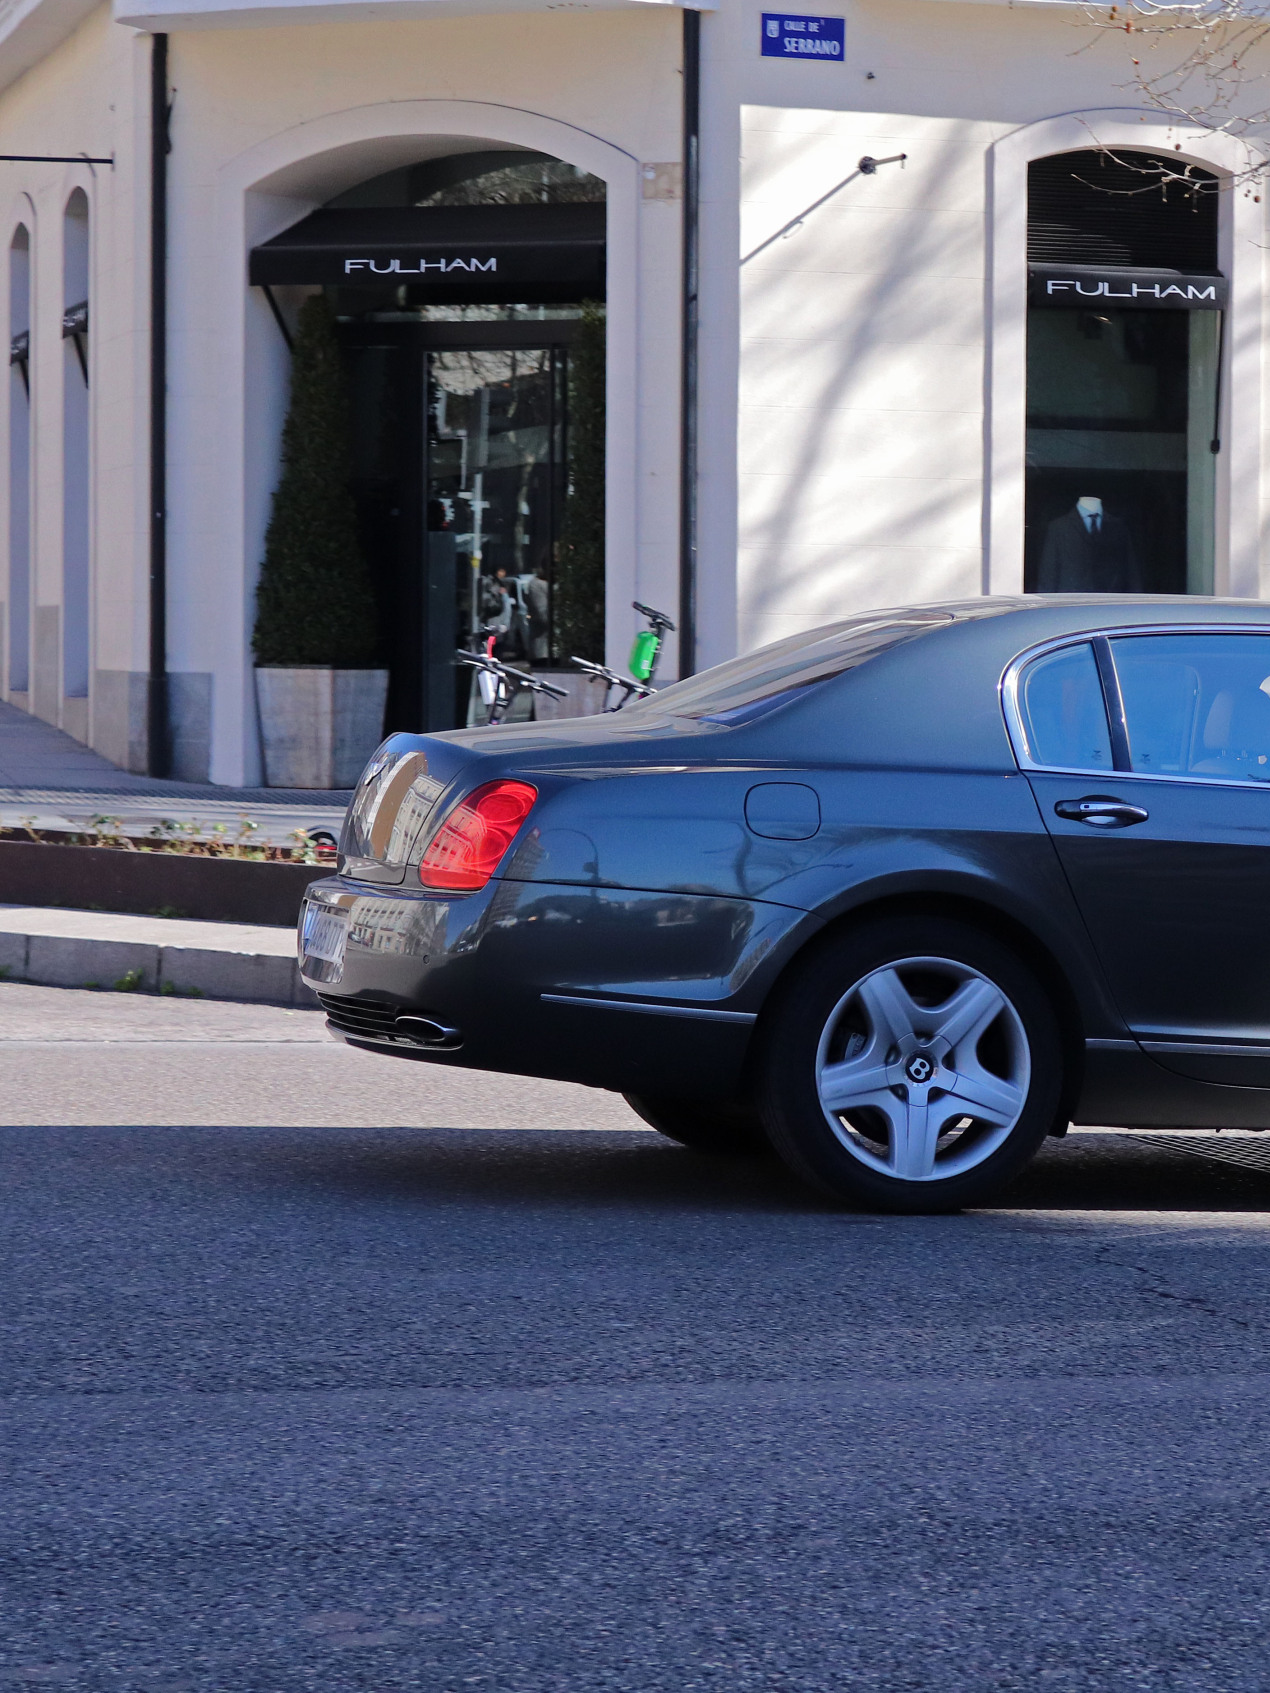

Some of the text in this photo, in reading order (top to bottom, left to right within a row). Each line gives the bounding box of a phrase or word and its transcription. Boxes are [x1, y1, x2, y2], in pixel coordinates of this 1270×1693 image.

[783, 20, 820, 33] CALLE DE
[783, 37, 840, 55] SERRANO
[344, 257, 498, 274] FULHAM
[1046, 279, 1217, 301] FULHAM
